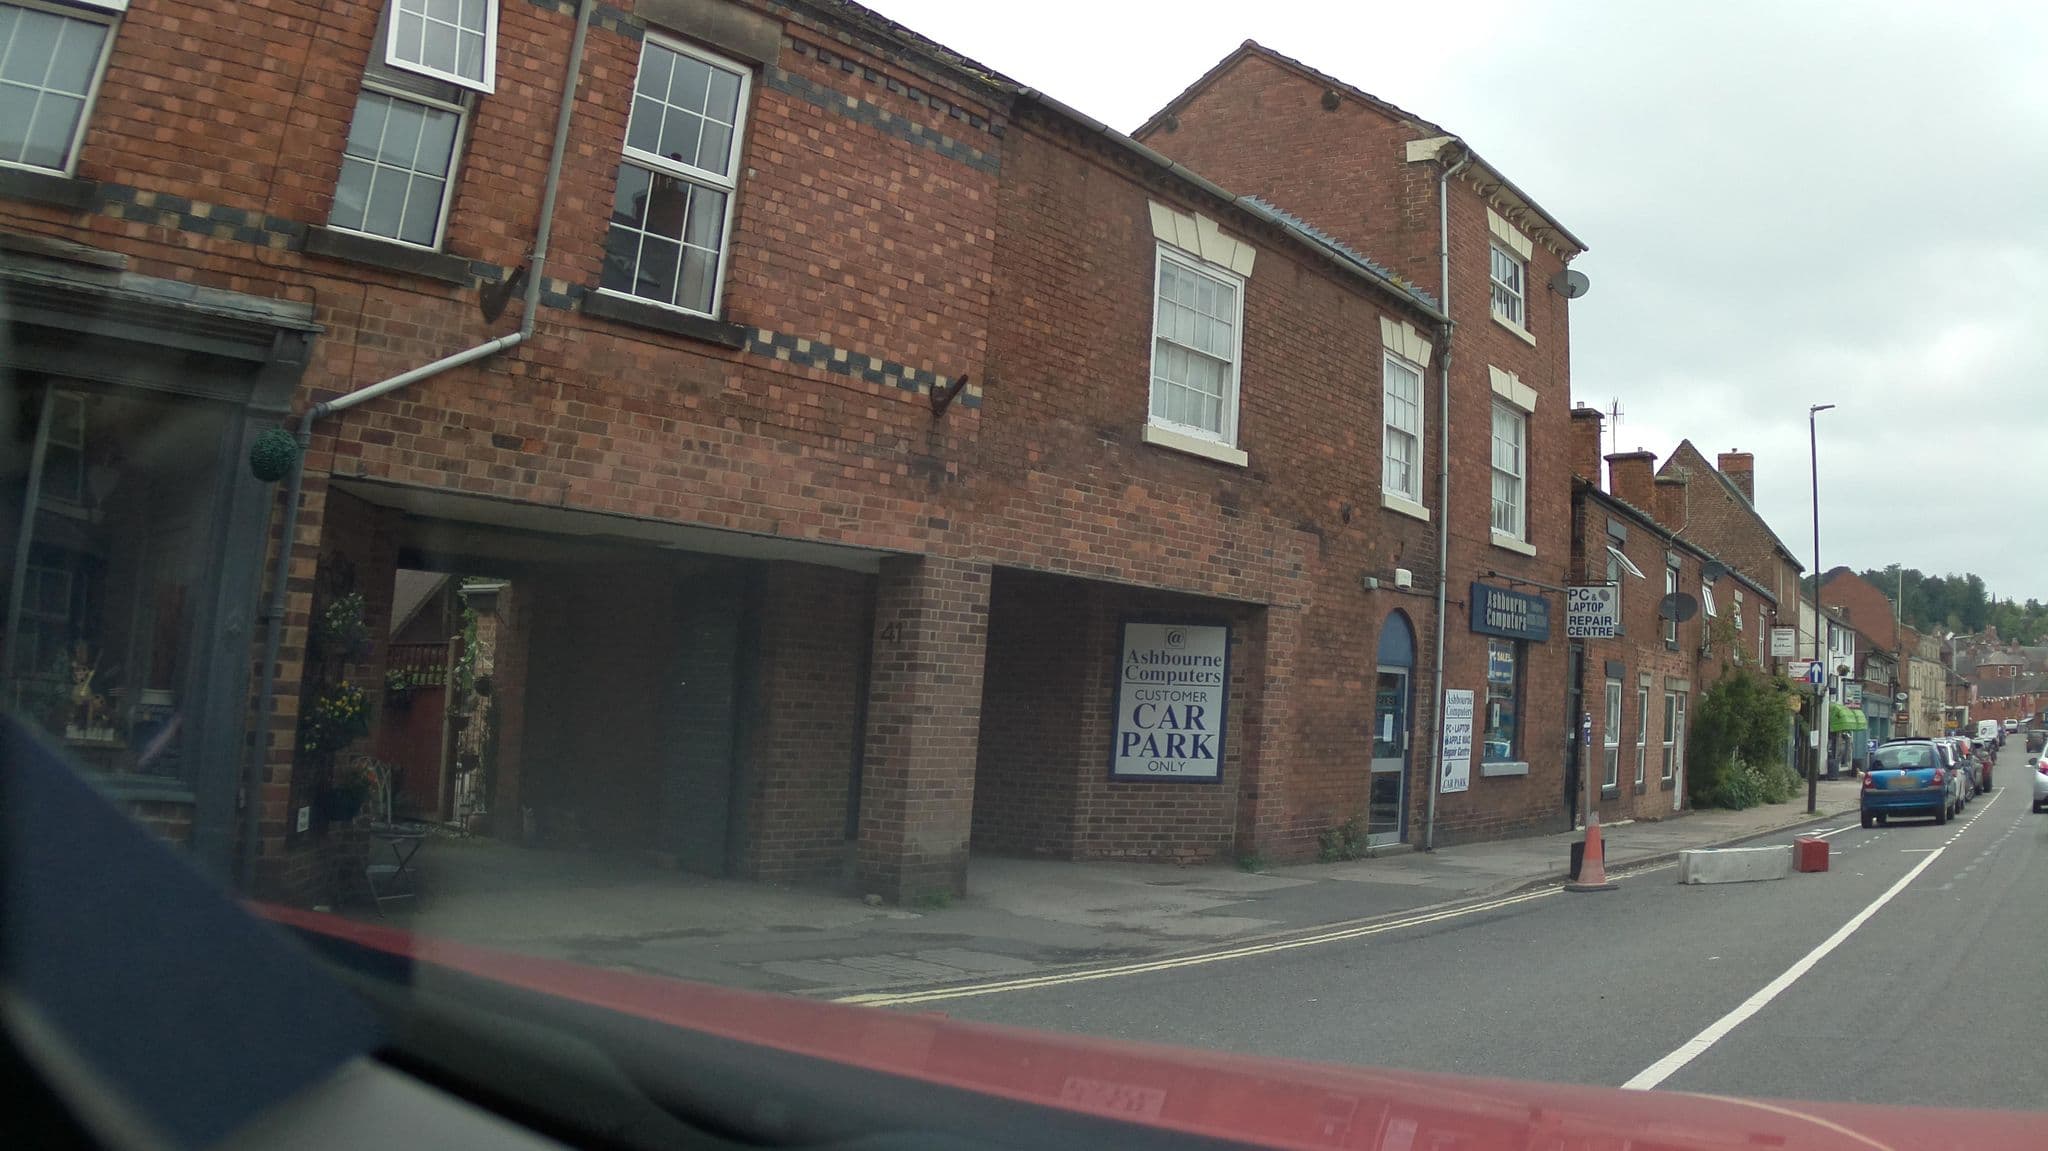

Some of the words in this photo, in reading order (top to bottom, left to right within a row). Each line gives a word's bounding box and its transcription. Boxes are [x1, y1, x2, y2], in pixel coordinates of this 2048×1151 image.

[1569, 589, 1589, 601] PC
[1487, 590, 1527, 614] Ashbourne
[1568, 602, 1604, 613] LAPTOP
[1486, 608, 1527, 631] Computers
[1569, 615, 1612, 626] REPAIR
[881, 621, 904, 644] 41
[1568, 626, 1614, 636] CENTRE
[1126, 649, 1222, 667] Ashbourne
[1124, 665, 1221, 685] Computers
[1135, 690, 1208, 703] CUSTOMER
[1447, 691, 1472, 704] Ashbourne
[1132, 703, 1206, 730] CAR
[1446, 706, 1472, 718] Computers
[1455, 723, 1470, 733] LAPTOP
[1120, 732, 1217, 759] PARK
[1449, 735, 1461, 745] APPLE
[1444, 748, 1457, 758] Repair
[1457, 747, 1470, 757] Centre
[1148, 760, 1186, 772] ONLY
[1443, 779, 1453, 789] CAR
[1454, 777, 1466, 788] PARK
